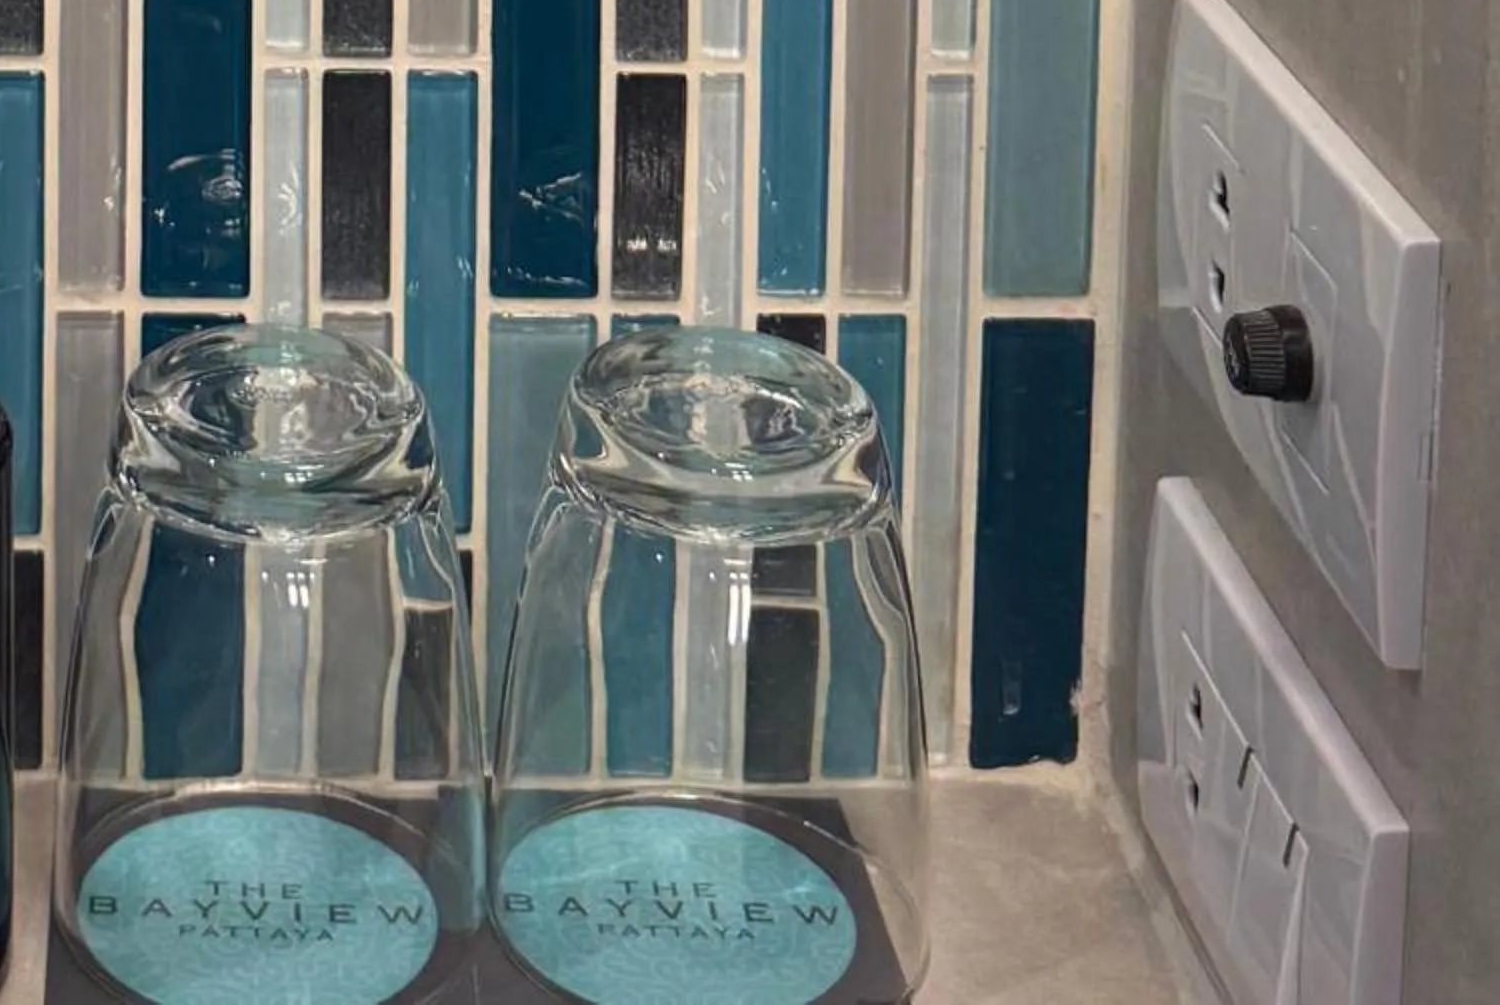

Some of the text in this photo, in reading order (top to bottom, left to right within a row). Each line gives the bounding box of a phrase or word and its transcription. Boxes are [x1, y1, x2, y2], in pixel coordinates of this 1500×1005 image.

[205, 881, 303, 900] THE
[615, 880, 717, 898] THE
[88, 895, 423, 925] BAYVIEW
[504, 893, 838, 926] BAYVIEW
[179, 923, 334, 941] PATTAYA
[598, 922, 754, 940] PATTAYA
